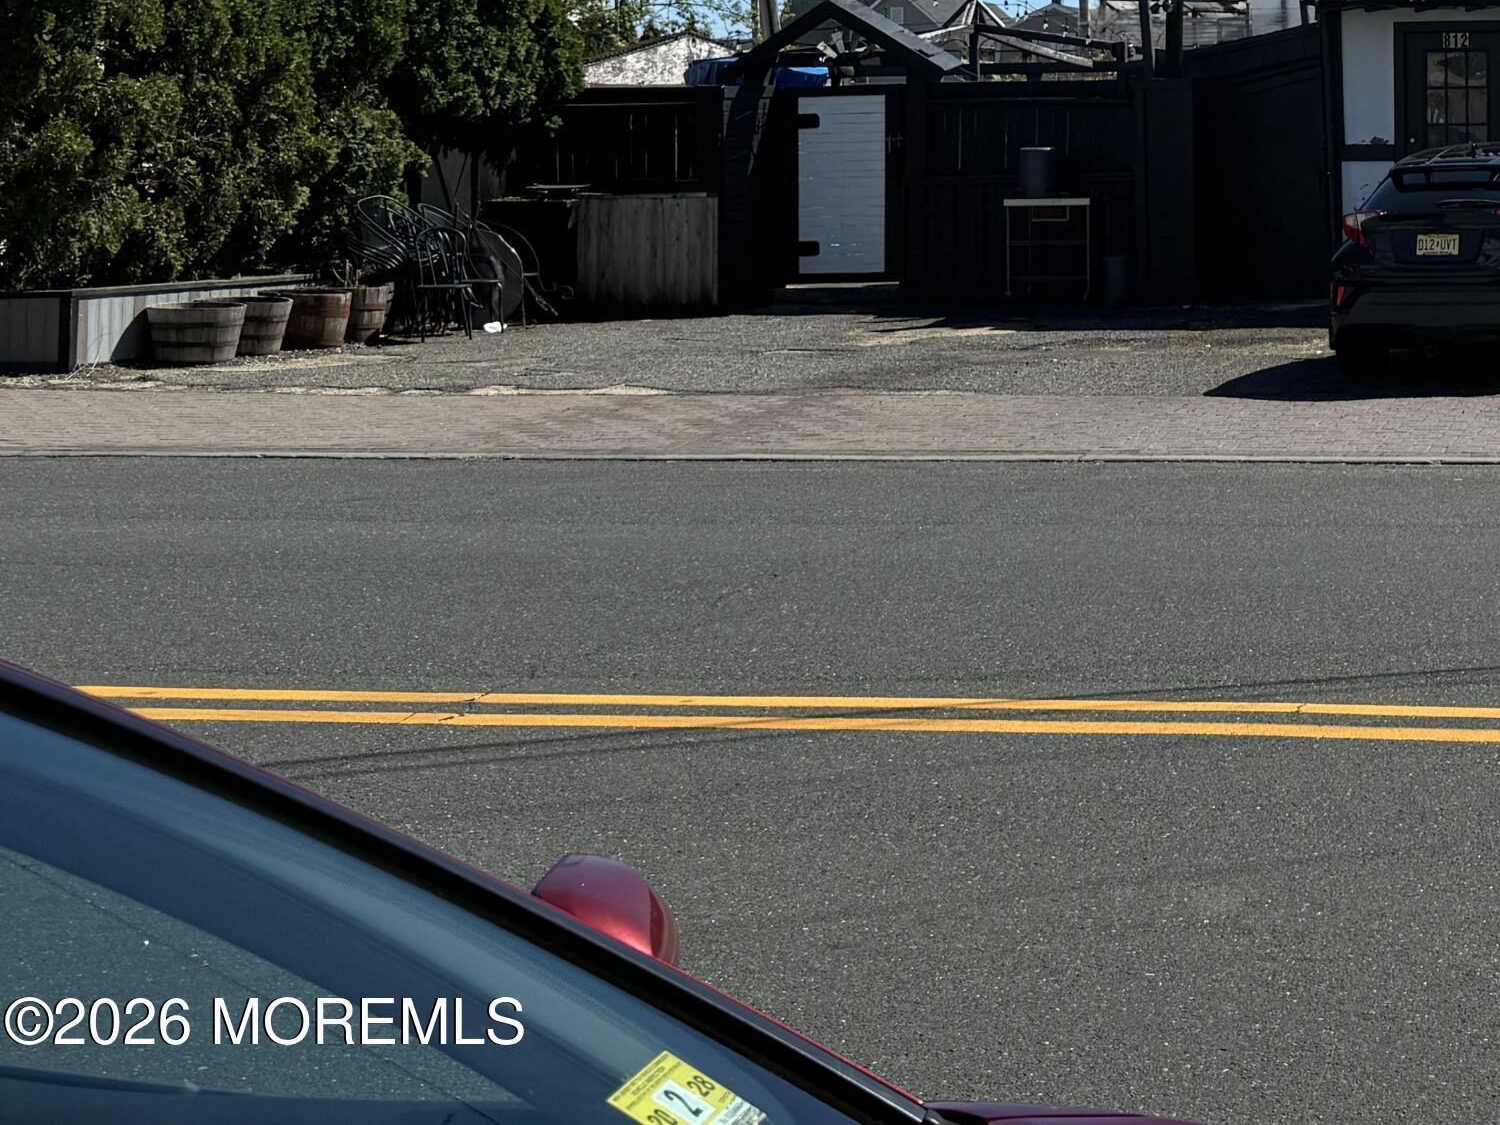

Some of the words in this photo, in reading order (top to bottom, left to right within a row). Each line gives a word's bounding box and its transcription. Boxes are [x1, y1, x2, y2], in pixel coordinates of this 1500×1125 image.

[1443, 32, 1468, 47] 812
[664, 1089, 703, 1117] 2
[686, 1075, 716, 1097] 28
